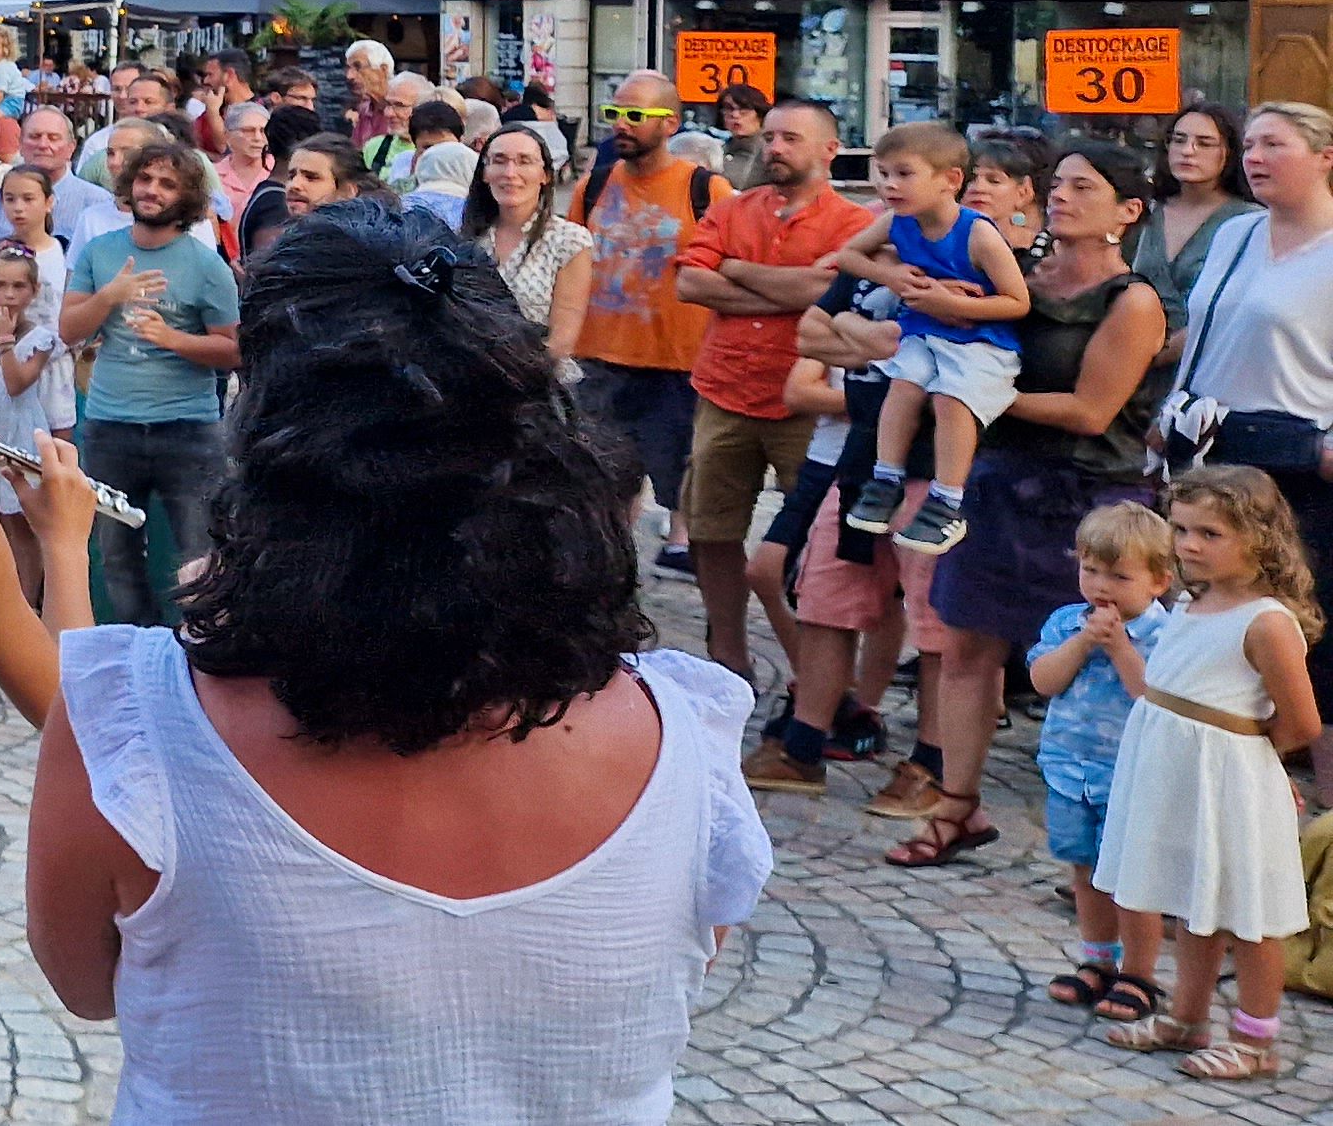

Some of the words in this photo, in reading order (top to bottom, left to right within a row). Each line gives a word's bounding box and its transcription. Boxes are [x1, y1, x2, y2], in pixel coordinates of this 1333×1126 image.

[684, 38, 769, 53] DESTOCKAGE
[1052, 36, 1170, 53] DESTOCKAGE
[699, 63, 748, 94] 30
[1075, 66, 1146, 104] 30
